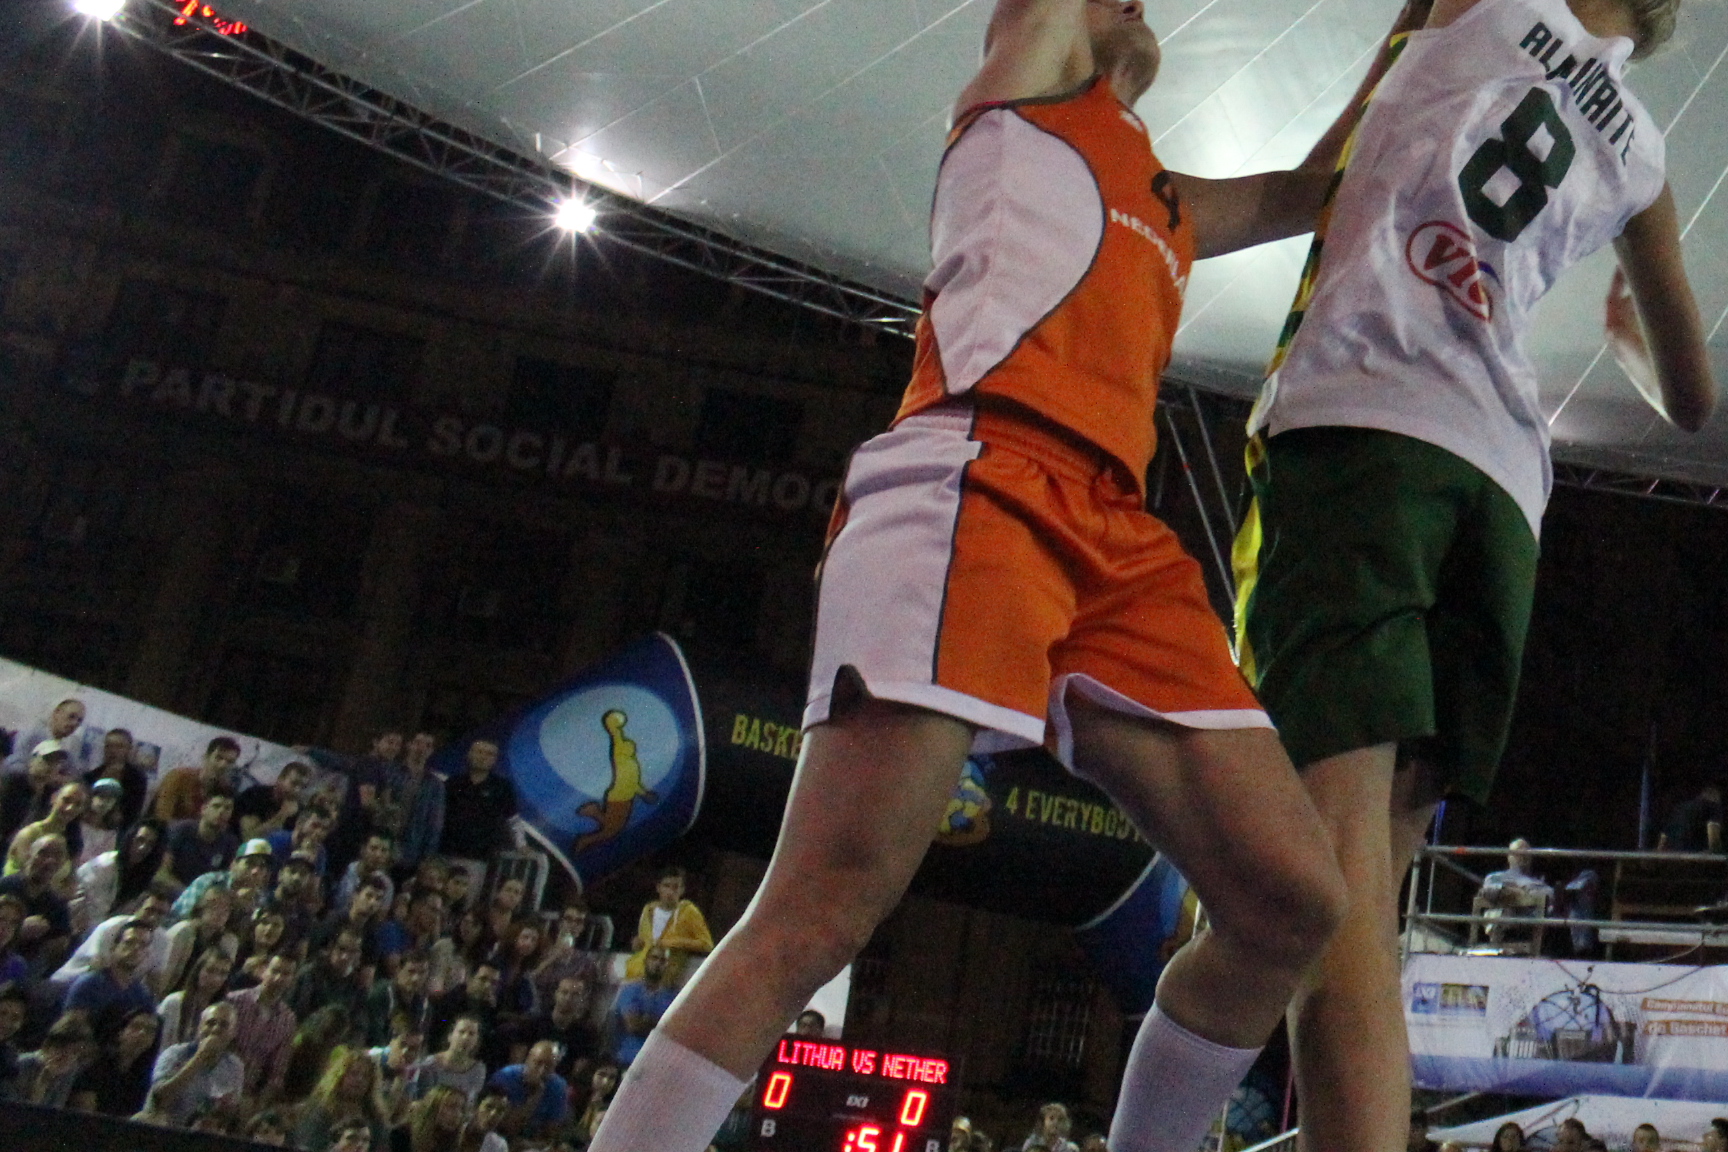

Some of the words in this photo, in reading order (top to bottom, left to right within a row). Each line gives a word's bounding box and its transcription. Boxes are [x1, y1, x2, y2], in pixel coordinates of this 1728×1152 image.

[1457, 86, 1576, 243] 8
[119, 357, 408, 448] PARTIDUL
[426, 415, 633, 486] SOCIAL
[1005, 786, 1018, 815] 4
[777, 1039, 846, 1071] LITHUA
[852, 1049, 878, 1075] VS
[881, 1052, 949, 1085] NETHER
[763, 1071, 794, 1110] 0
[900, 1089, 929, 1127] 0
